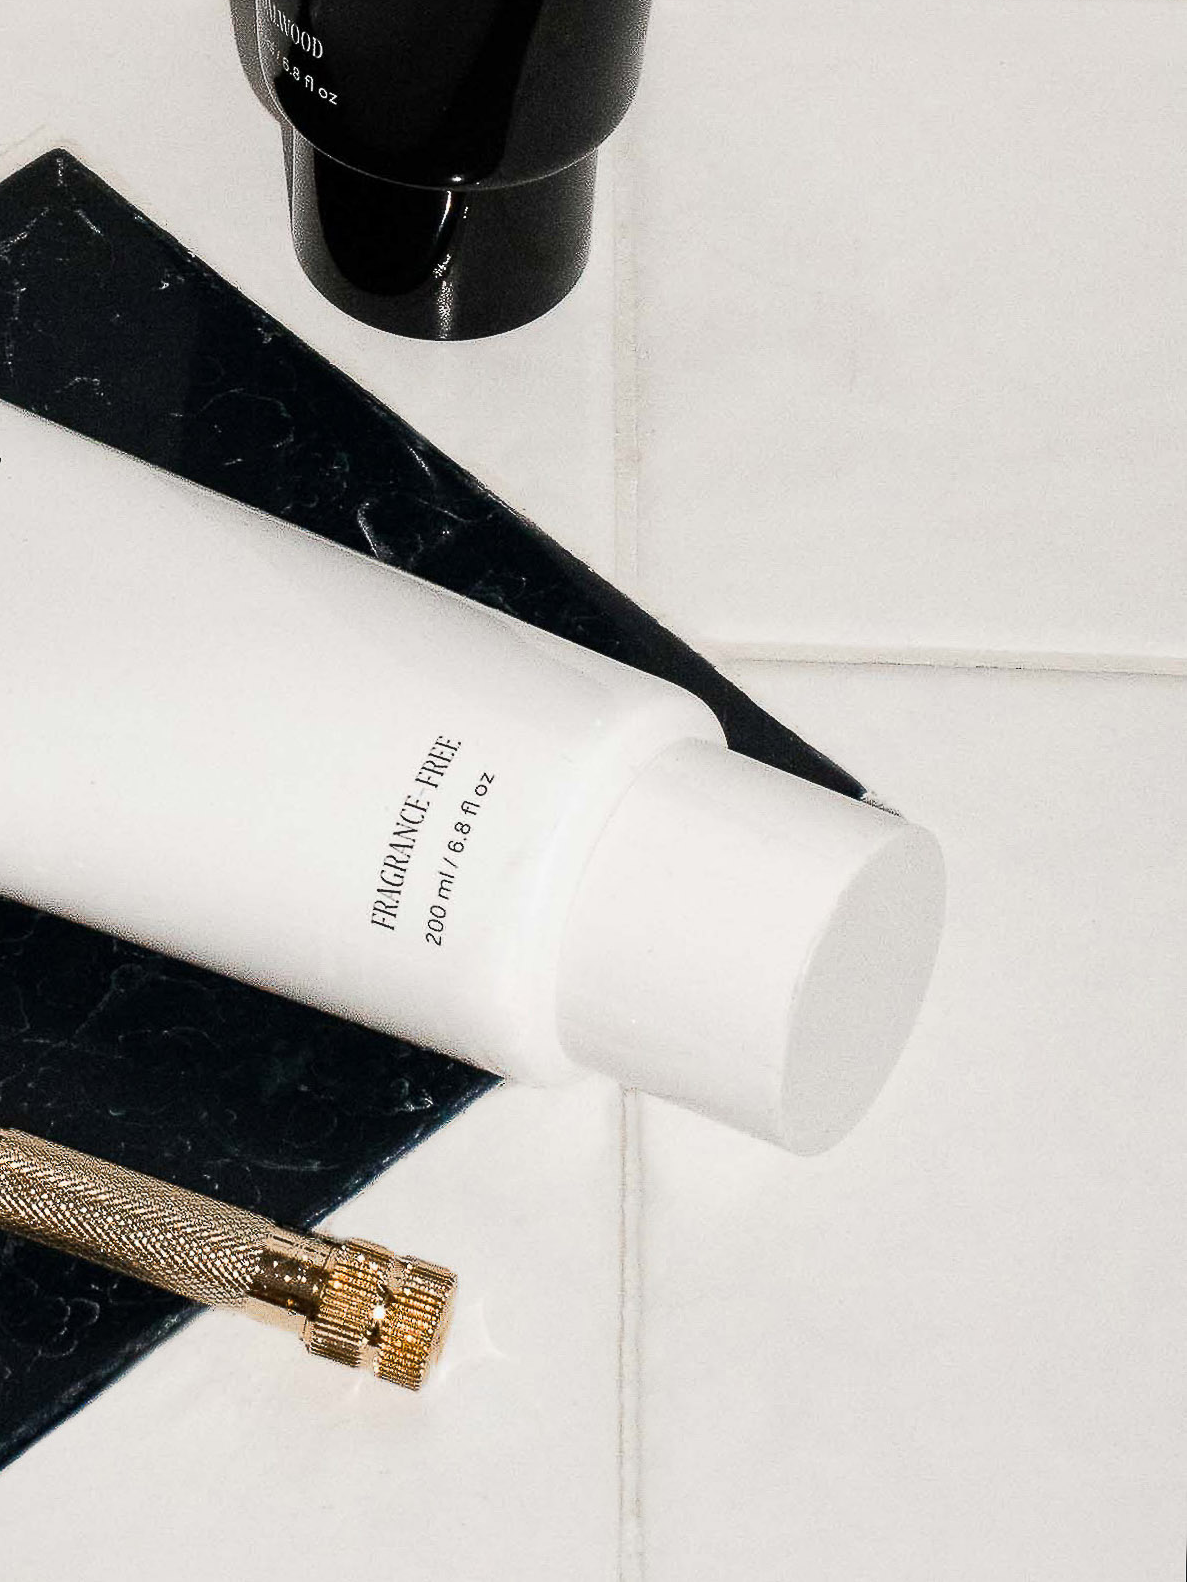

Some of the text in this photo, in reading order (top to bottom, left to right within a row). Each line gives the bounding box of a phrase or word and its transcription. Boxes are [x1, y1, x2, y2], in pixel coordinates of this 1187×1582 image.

[282, 56, 301, 82] 6.8
[304, 74, 314, 92] fl
[318, 87, 338, 105] oz
[425, 904, 447, 947] 200
[437, 870, 456, 901] ml
[447, 820, 472, 854] 6.8
[460, 800, 481, 816] fl
[474, 772, 496, 797] oz
